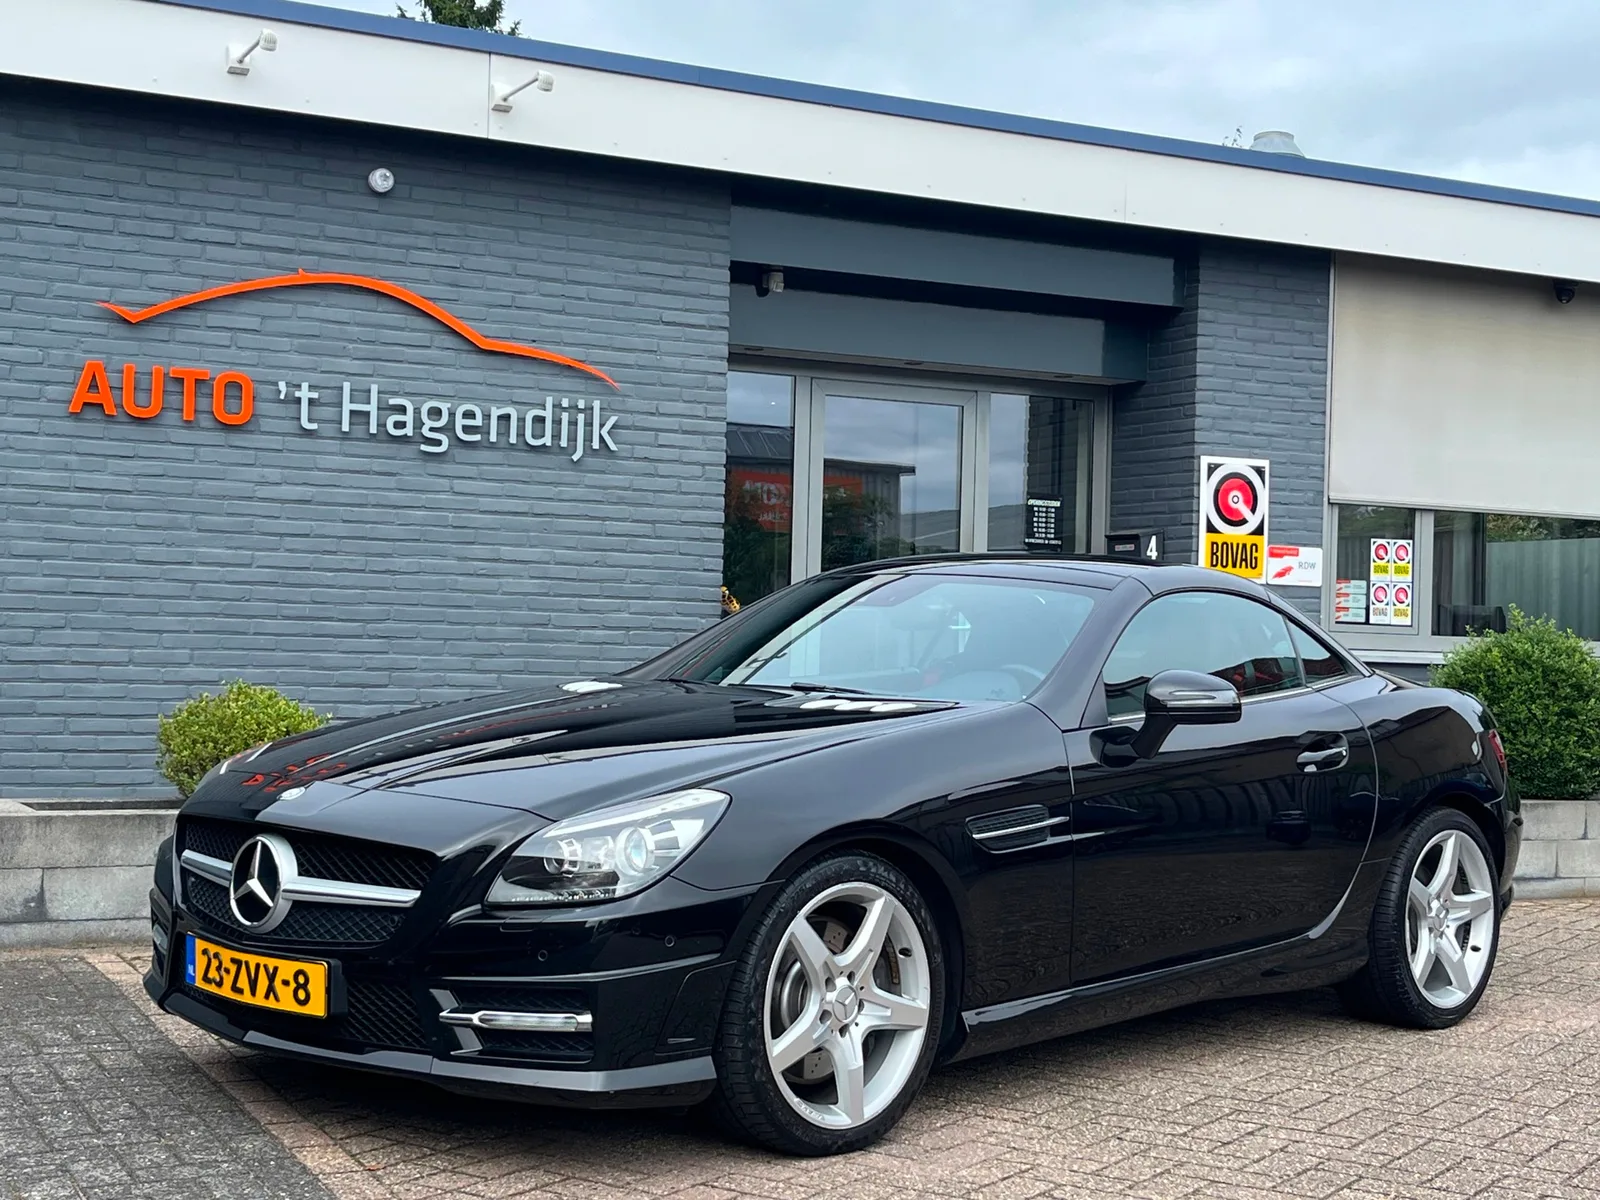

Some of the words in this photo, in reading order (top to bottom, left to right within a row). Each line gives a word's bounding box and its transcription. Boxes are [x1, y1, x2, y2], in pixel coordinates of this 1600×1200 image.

[68, 360, 255, 426] AUTO
[340, 380, 619, 462] Hagendijk
[1146, 535, 1158, 560] 4
[1210, 541, 1259, 570] BOVAG
[1298, 561, 1316, 570] RDW
[1373, 564, 1389, 574] BOVAG
[201, 948, 311, 1006] 23-ZVX-8
